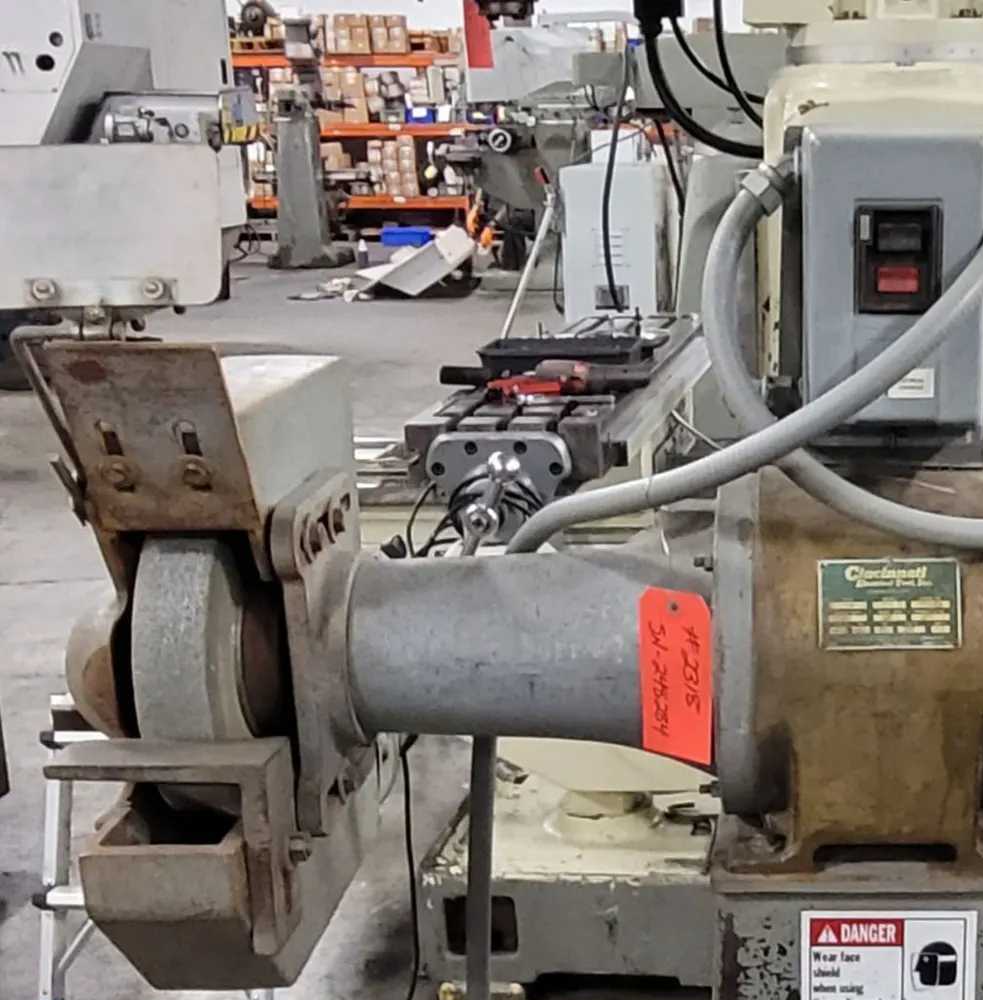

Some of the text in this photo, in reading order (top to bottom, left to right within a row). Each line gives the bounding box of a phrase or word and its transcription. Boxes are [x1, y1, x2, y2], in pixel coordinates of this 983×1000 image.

[840, 923, 897, 944] DANGER
[812, 951, 861, 963] Wear face
[812, 983, 864, 995] when using
